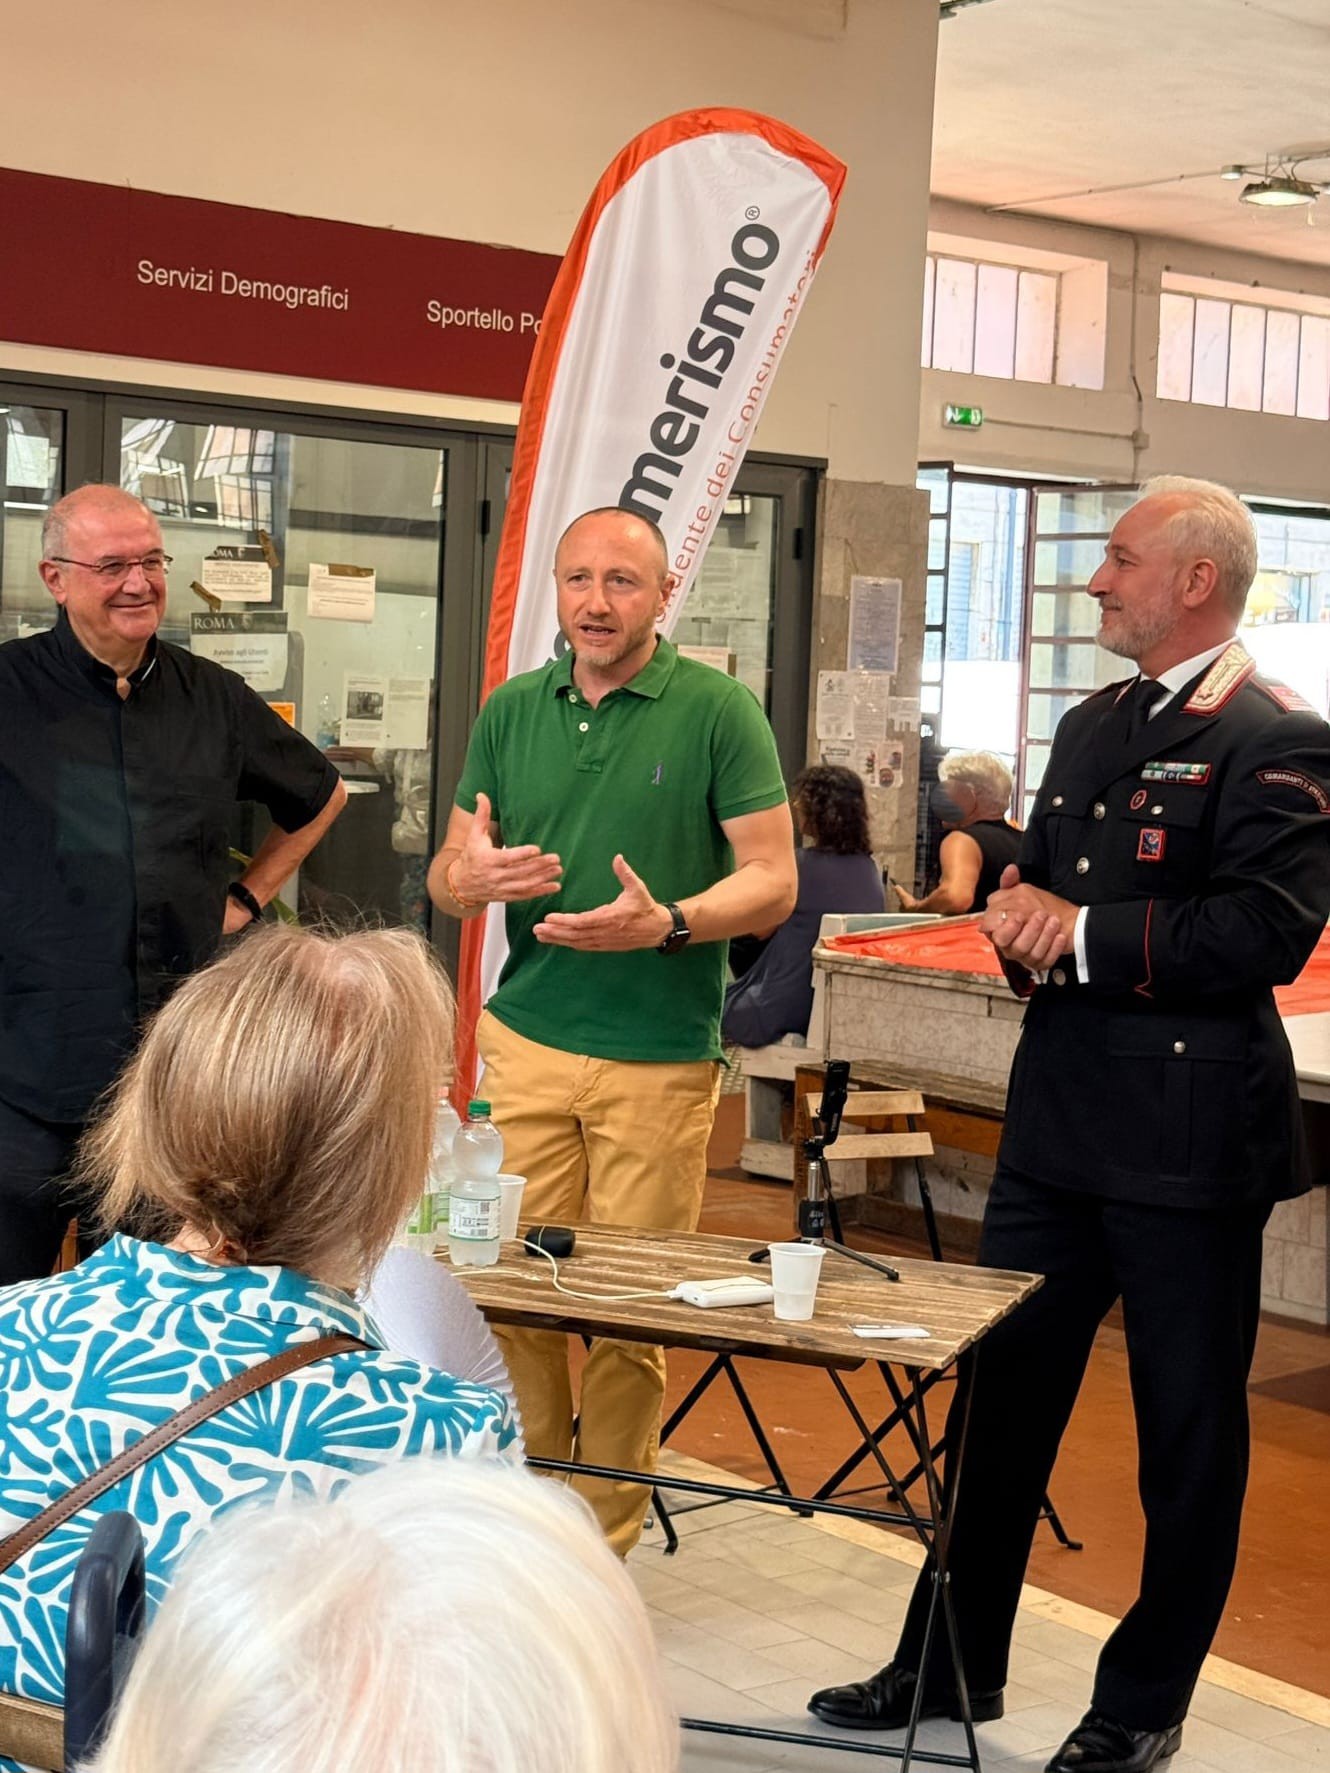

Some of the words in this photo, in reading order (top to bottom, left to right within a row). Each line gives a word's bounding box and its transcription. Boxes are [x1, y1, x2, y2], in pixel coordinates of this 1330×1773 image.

[137, 259, 213, 292] Servizi
[220, 271, 349, 310] Demografici
[427, 300, 514, 332] Sportello
[520, 312, 542, 335] Po
[707, 450, 735, 498] dei
[213, 548, 233, 557] OMA
[194, 617, 235, 629] ROMA
